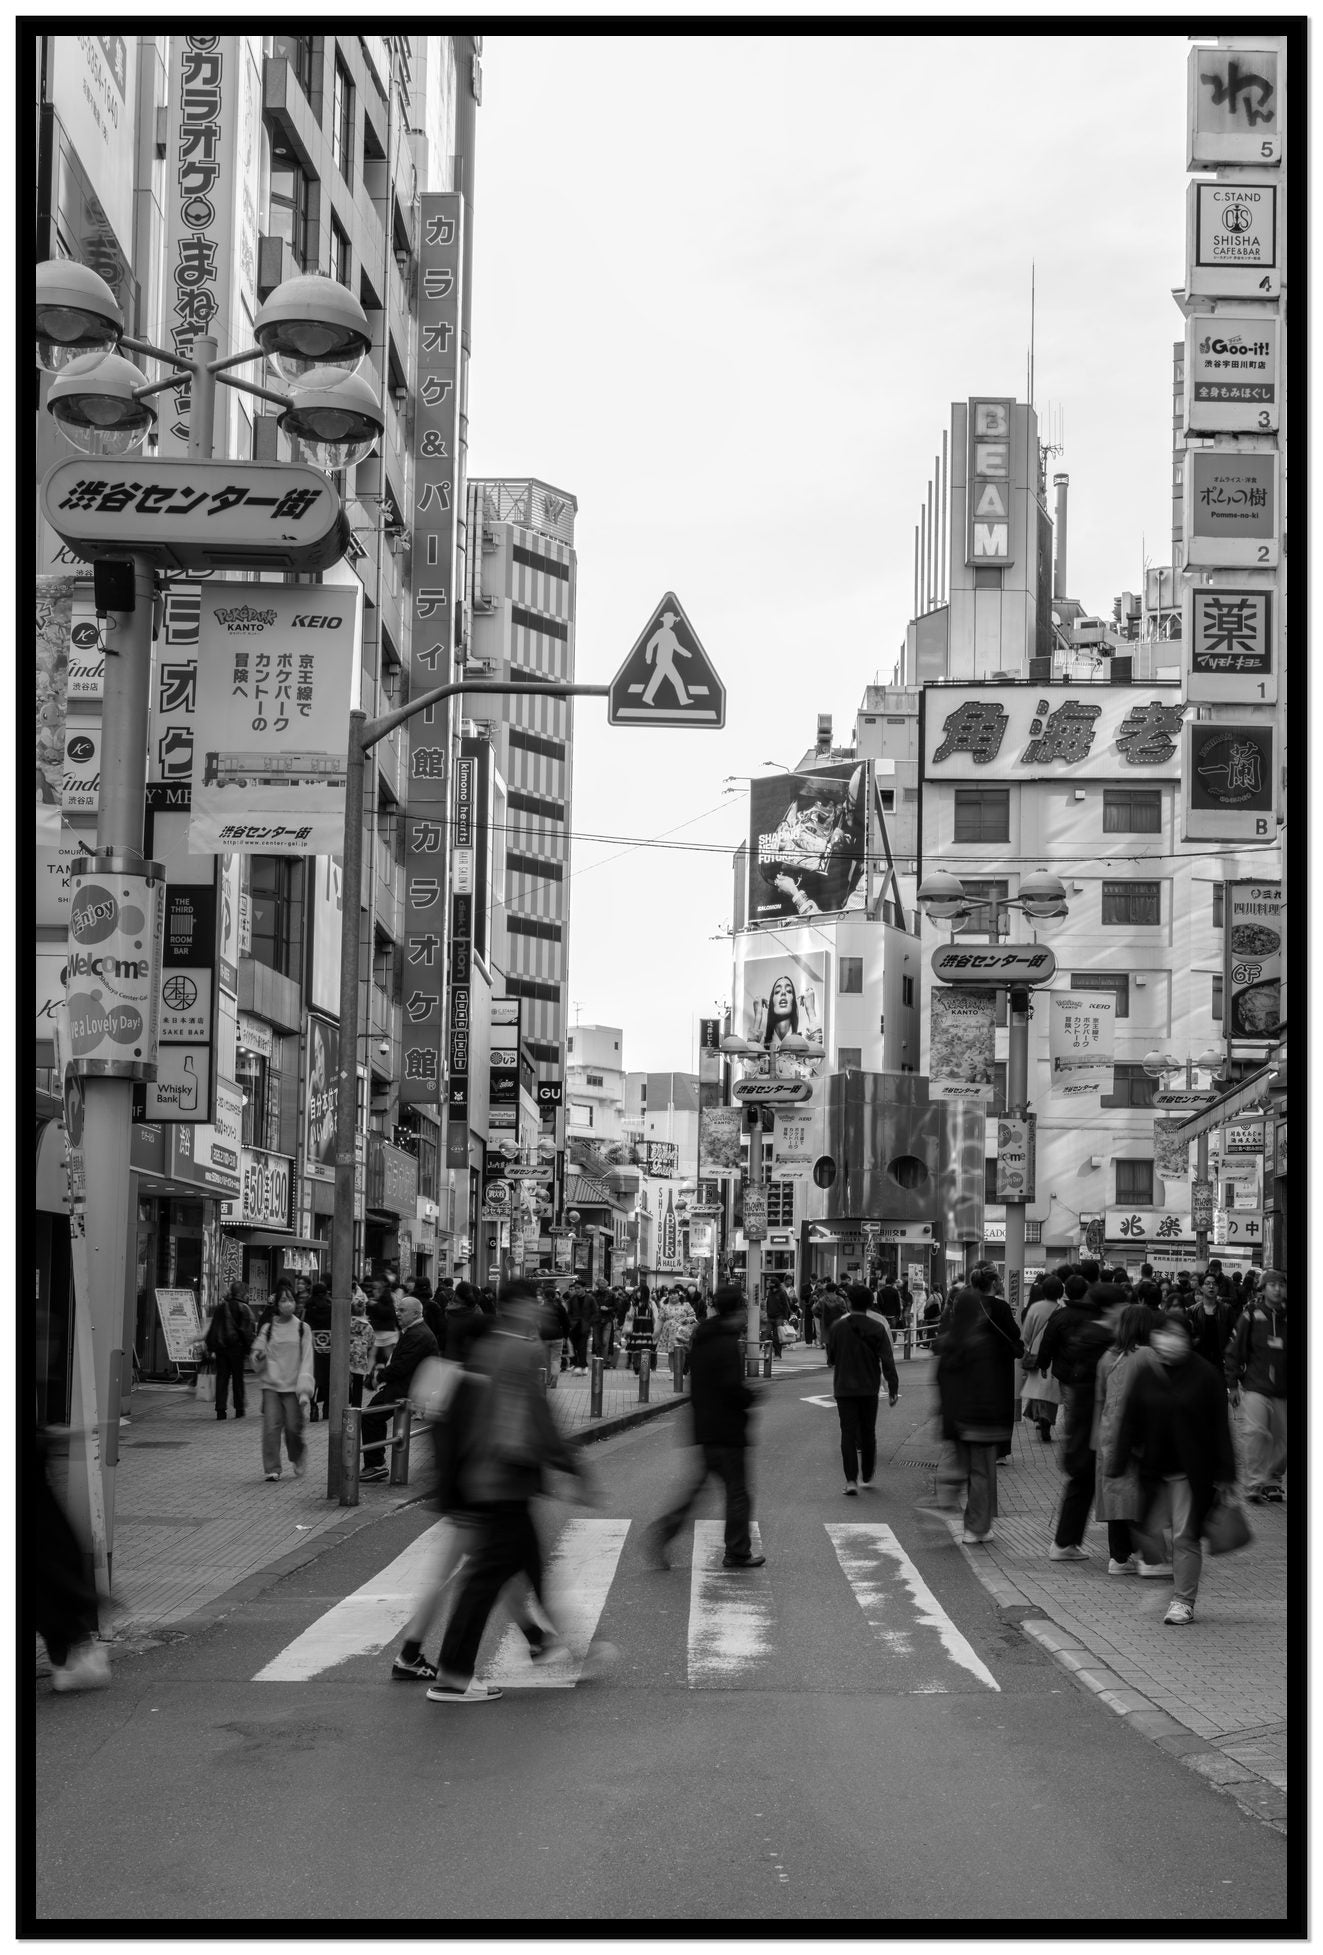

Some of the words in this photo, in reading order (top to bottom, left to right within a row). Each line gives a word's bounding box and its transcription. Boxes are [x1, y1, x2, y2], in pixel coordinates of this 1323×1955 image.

[178, 51, 222, 198] カラオケ
[1260, 141, 1274, 158] 5
[1213, 191, 1262, 202] C.STAND
[1213, 235, 1261, 247] SHISHA
[1211, 338, 1270, 357] Goo-it!
[1204, 359, 1267, 369] 渋谷宇田川町店
[1199, 386, 1272, 399] 全身もみほぐし
[1258, 410, 1271, 428] 3
[974, 402, 1009, 557] BEAM
[58, 480, 323, 520] 渋谷センター街
[1199, 486, 1268, 508] ポムの樹
[1257, 546, 1270, 562] 2
[227, 623, 265, 631] KANTO
[291, 615, 343, 629] KEIO
[1203, 597, 1258, 652] 薬
[1197, 654, 1264, 670] マツモトキヨシ
[232, 652, 250, 698] 冒険へ
[72, 682, 98, 691] 渋谷店
[251, 653, 271, 732] カントーの
[296, 654, 315, 717] 京王線で
[1256, 682, 1267, 699] 1
[932, 700, 1188, 764] 角海老
[1198, 741, 1262, 793] 一蘭
[460, 763, 470, 801] kimono
[68, 796, 94, 805] 渋谷店
[219, 825, 313, 840] 渋谷センター街
[1255, 818, 1268, 836] B
[72, 900, 114, 937] Enjoy
[403, 820, 445, 1081] カラオケ館
[67, 952, 149, 978] Welcome
[939, 954, 1048, 968] 渋谷センター街
[1232, 963, 1262, 984] 6F
[86, 1014, 118, 1035] Lovely
[120, 1014, 142, 1031] Day!
[157, 1084, 193, 1097] Whisky
[539, 1087, 561, 1099] GU
[737, 1084, 802, 1094] 渋谷センター街
[157, 1094, 178, 1103] Bank
[664, 1212, 675, 1258] BEER
[1119, 1215, 1183, 1238] 兆楽
